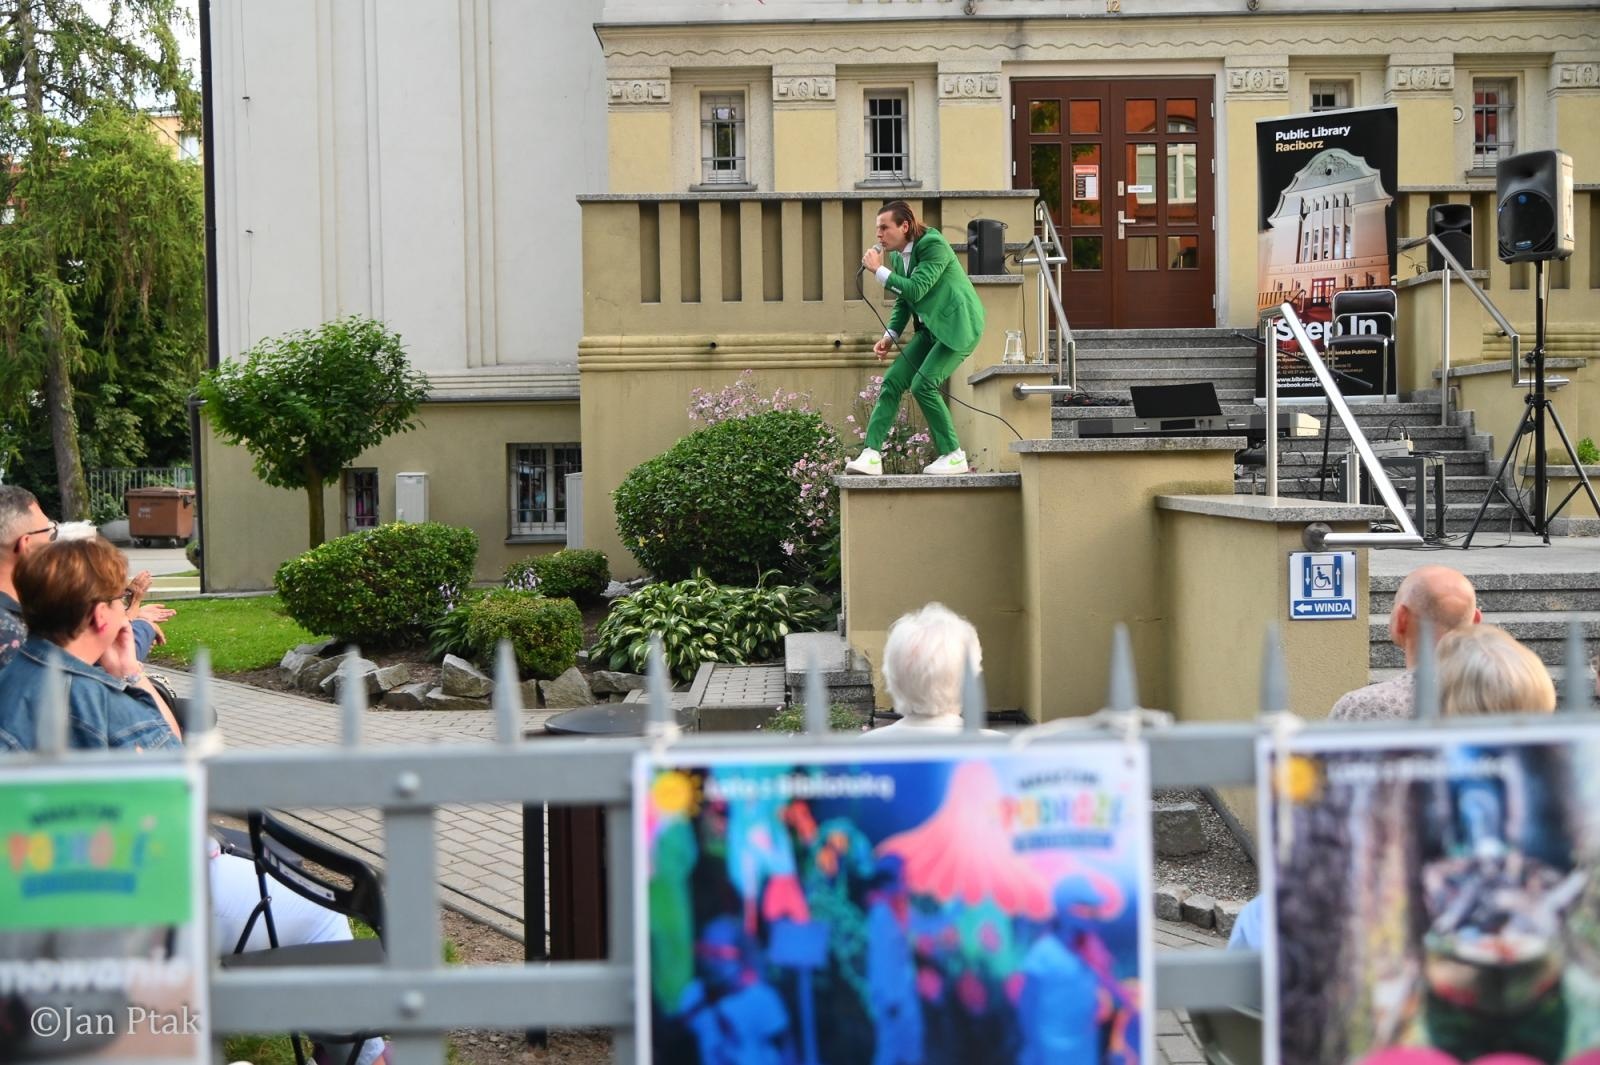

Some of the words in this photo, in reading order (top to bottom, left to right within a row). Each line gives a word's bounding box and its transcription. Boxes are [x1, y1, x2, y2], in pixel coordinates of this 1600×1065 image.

[1275, 128, 1310, 141] Public
[1311, 126, 1351, 138] Library
[1275, 140, 1324, 152] Raciborz
[1350, 315, 1378, 335] In
[1314, 603, 1351, 612] WINDA
